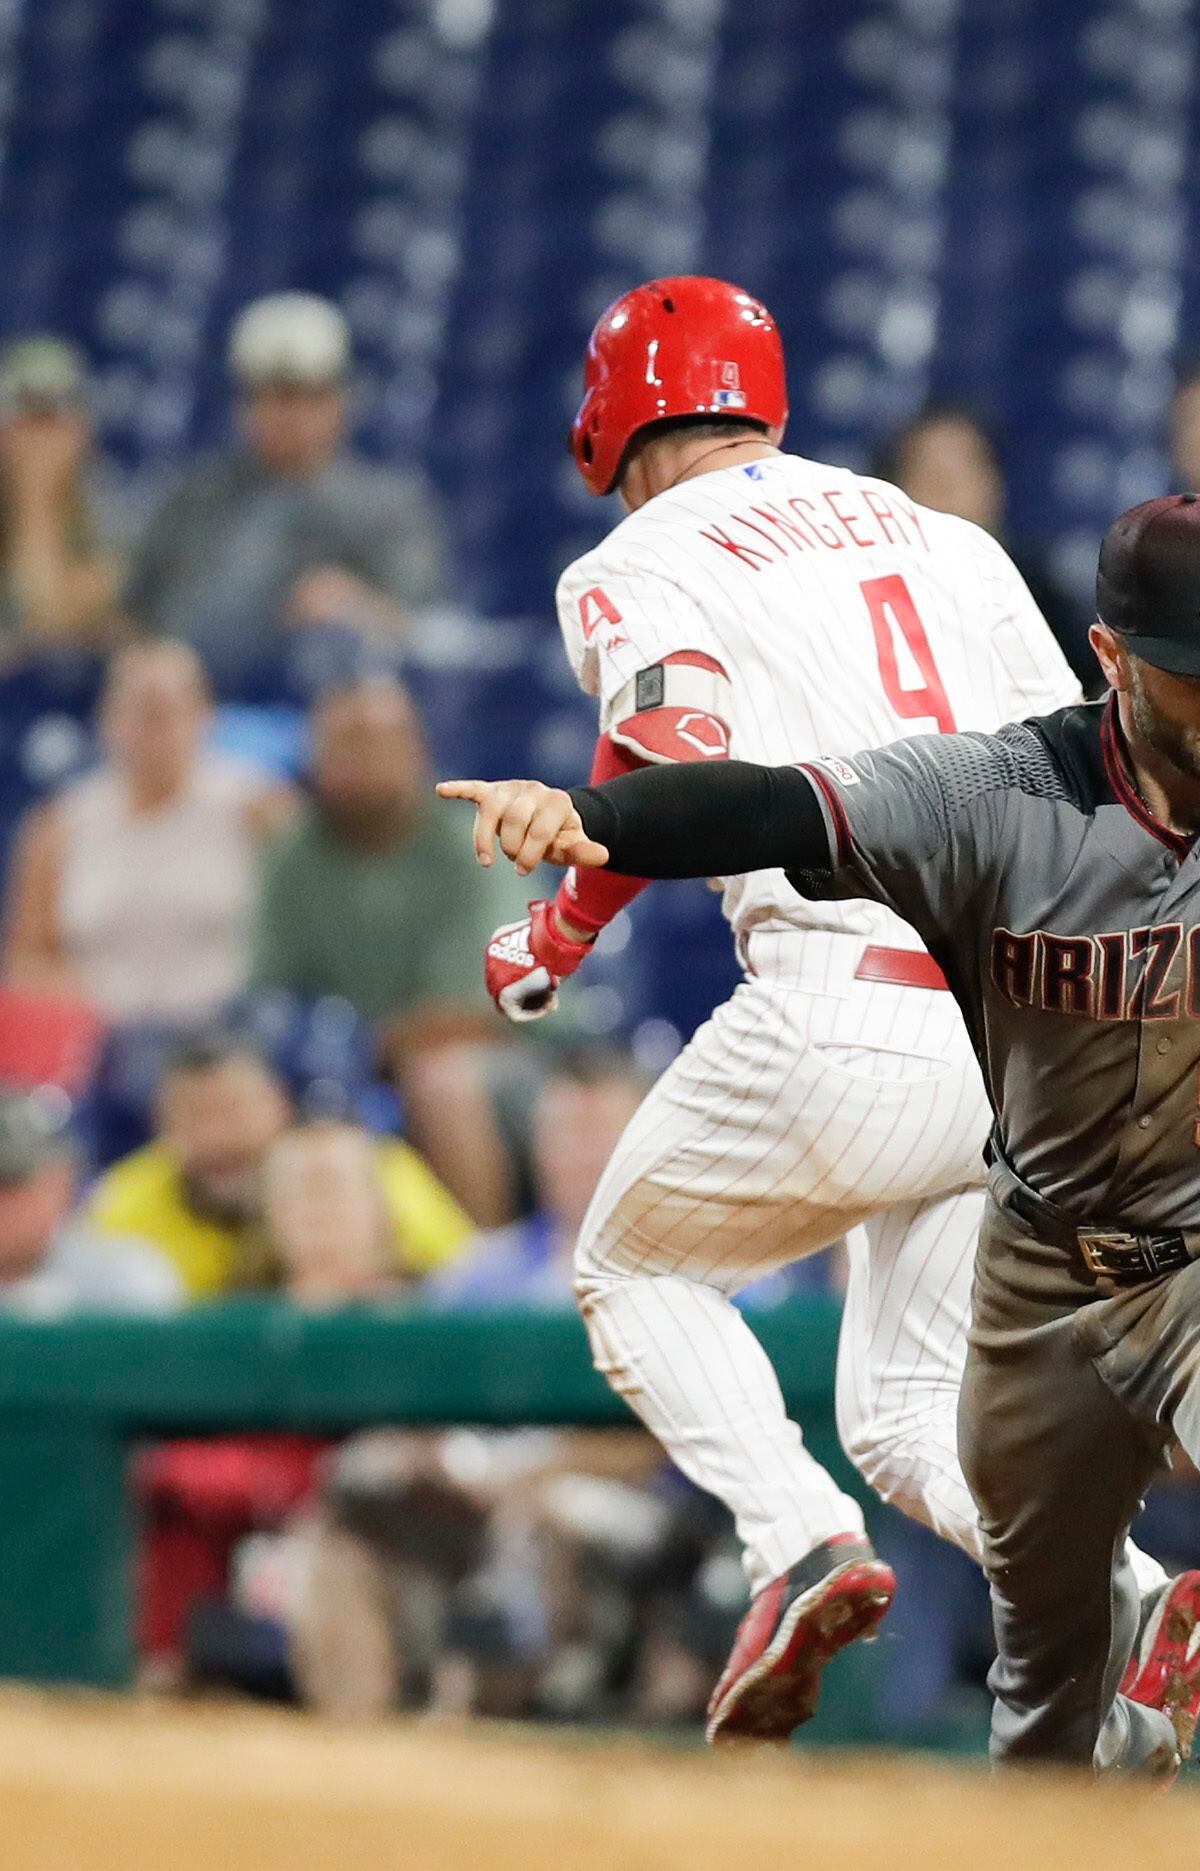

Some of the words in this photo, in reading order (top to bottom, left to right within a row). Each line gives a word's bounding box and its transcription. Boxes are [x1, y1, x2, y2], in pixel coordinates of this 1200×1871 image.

[699, 490, 930, 571] KINGERY
[860, 574, 958, 734] 4
[488, 943, 536, 967] adidas
